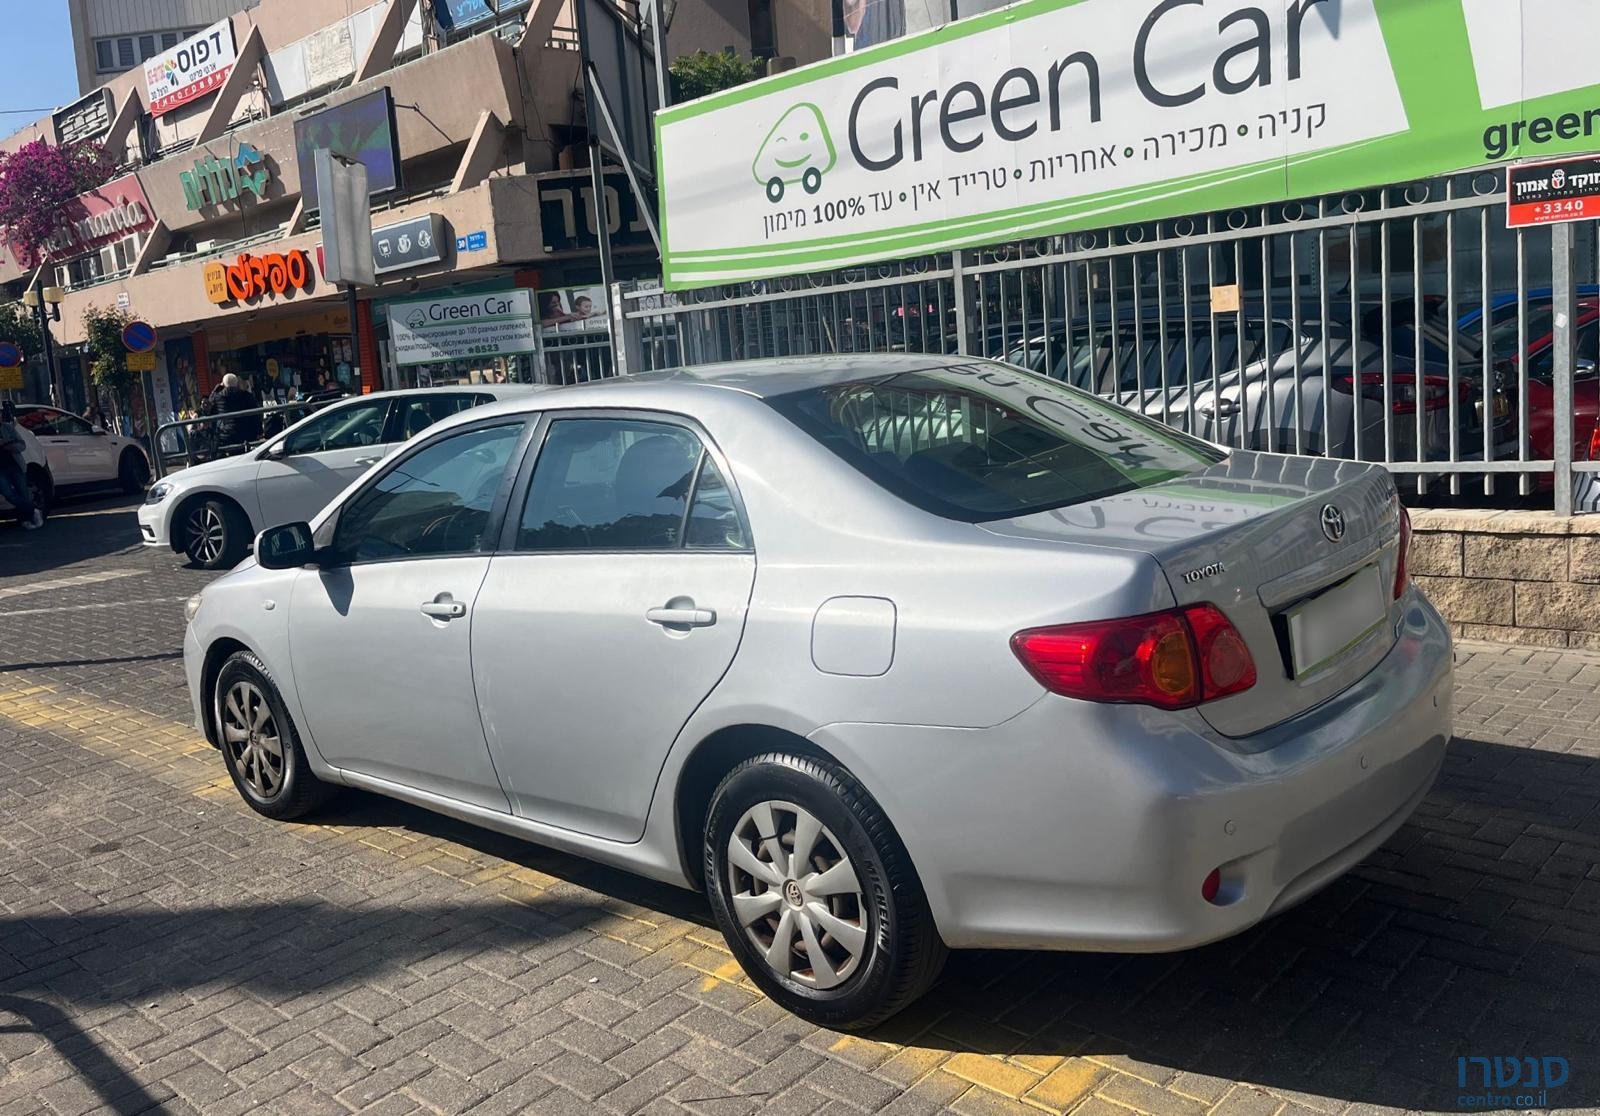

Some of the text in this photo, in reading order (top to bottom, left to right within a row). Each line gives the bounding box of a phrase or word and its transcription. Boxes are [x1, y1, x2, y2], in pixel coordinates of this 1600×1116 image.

[176, 31, 222, 73] דפוס
[848, 0, 1326, 172] Green Car
[763, 103, 1326, 239] קניה מכירה אחריות טרייד אין עד 100% מימון
[1516, 178, 1549, 196] אמון
[429, 297, 514, 321] Green Car
[466, 326, 478, 334] 100
[1181, 561, 1226, 585] TOYOTA
[864, 859, 891, 952] MICHELIN
